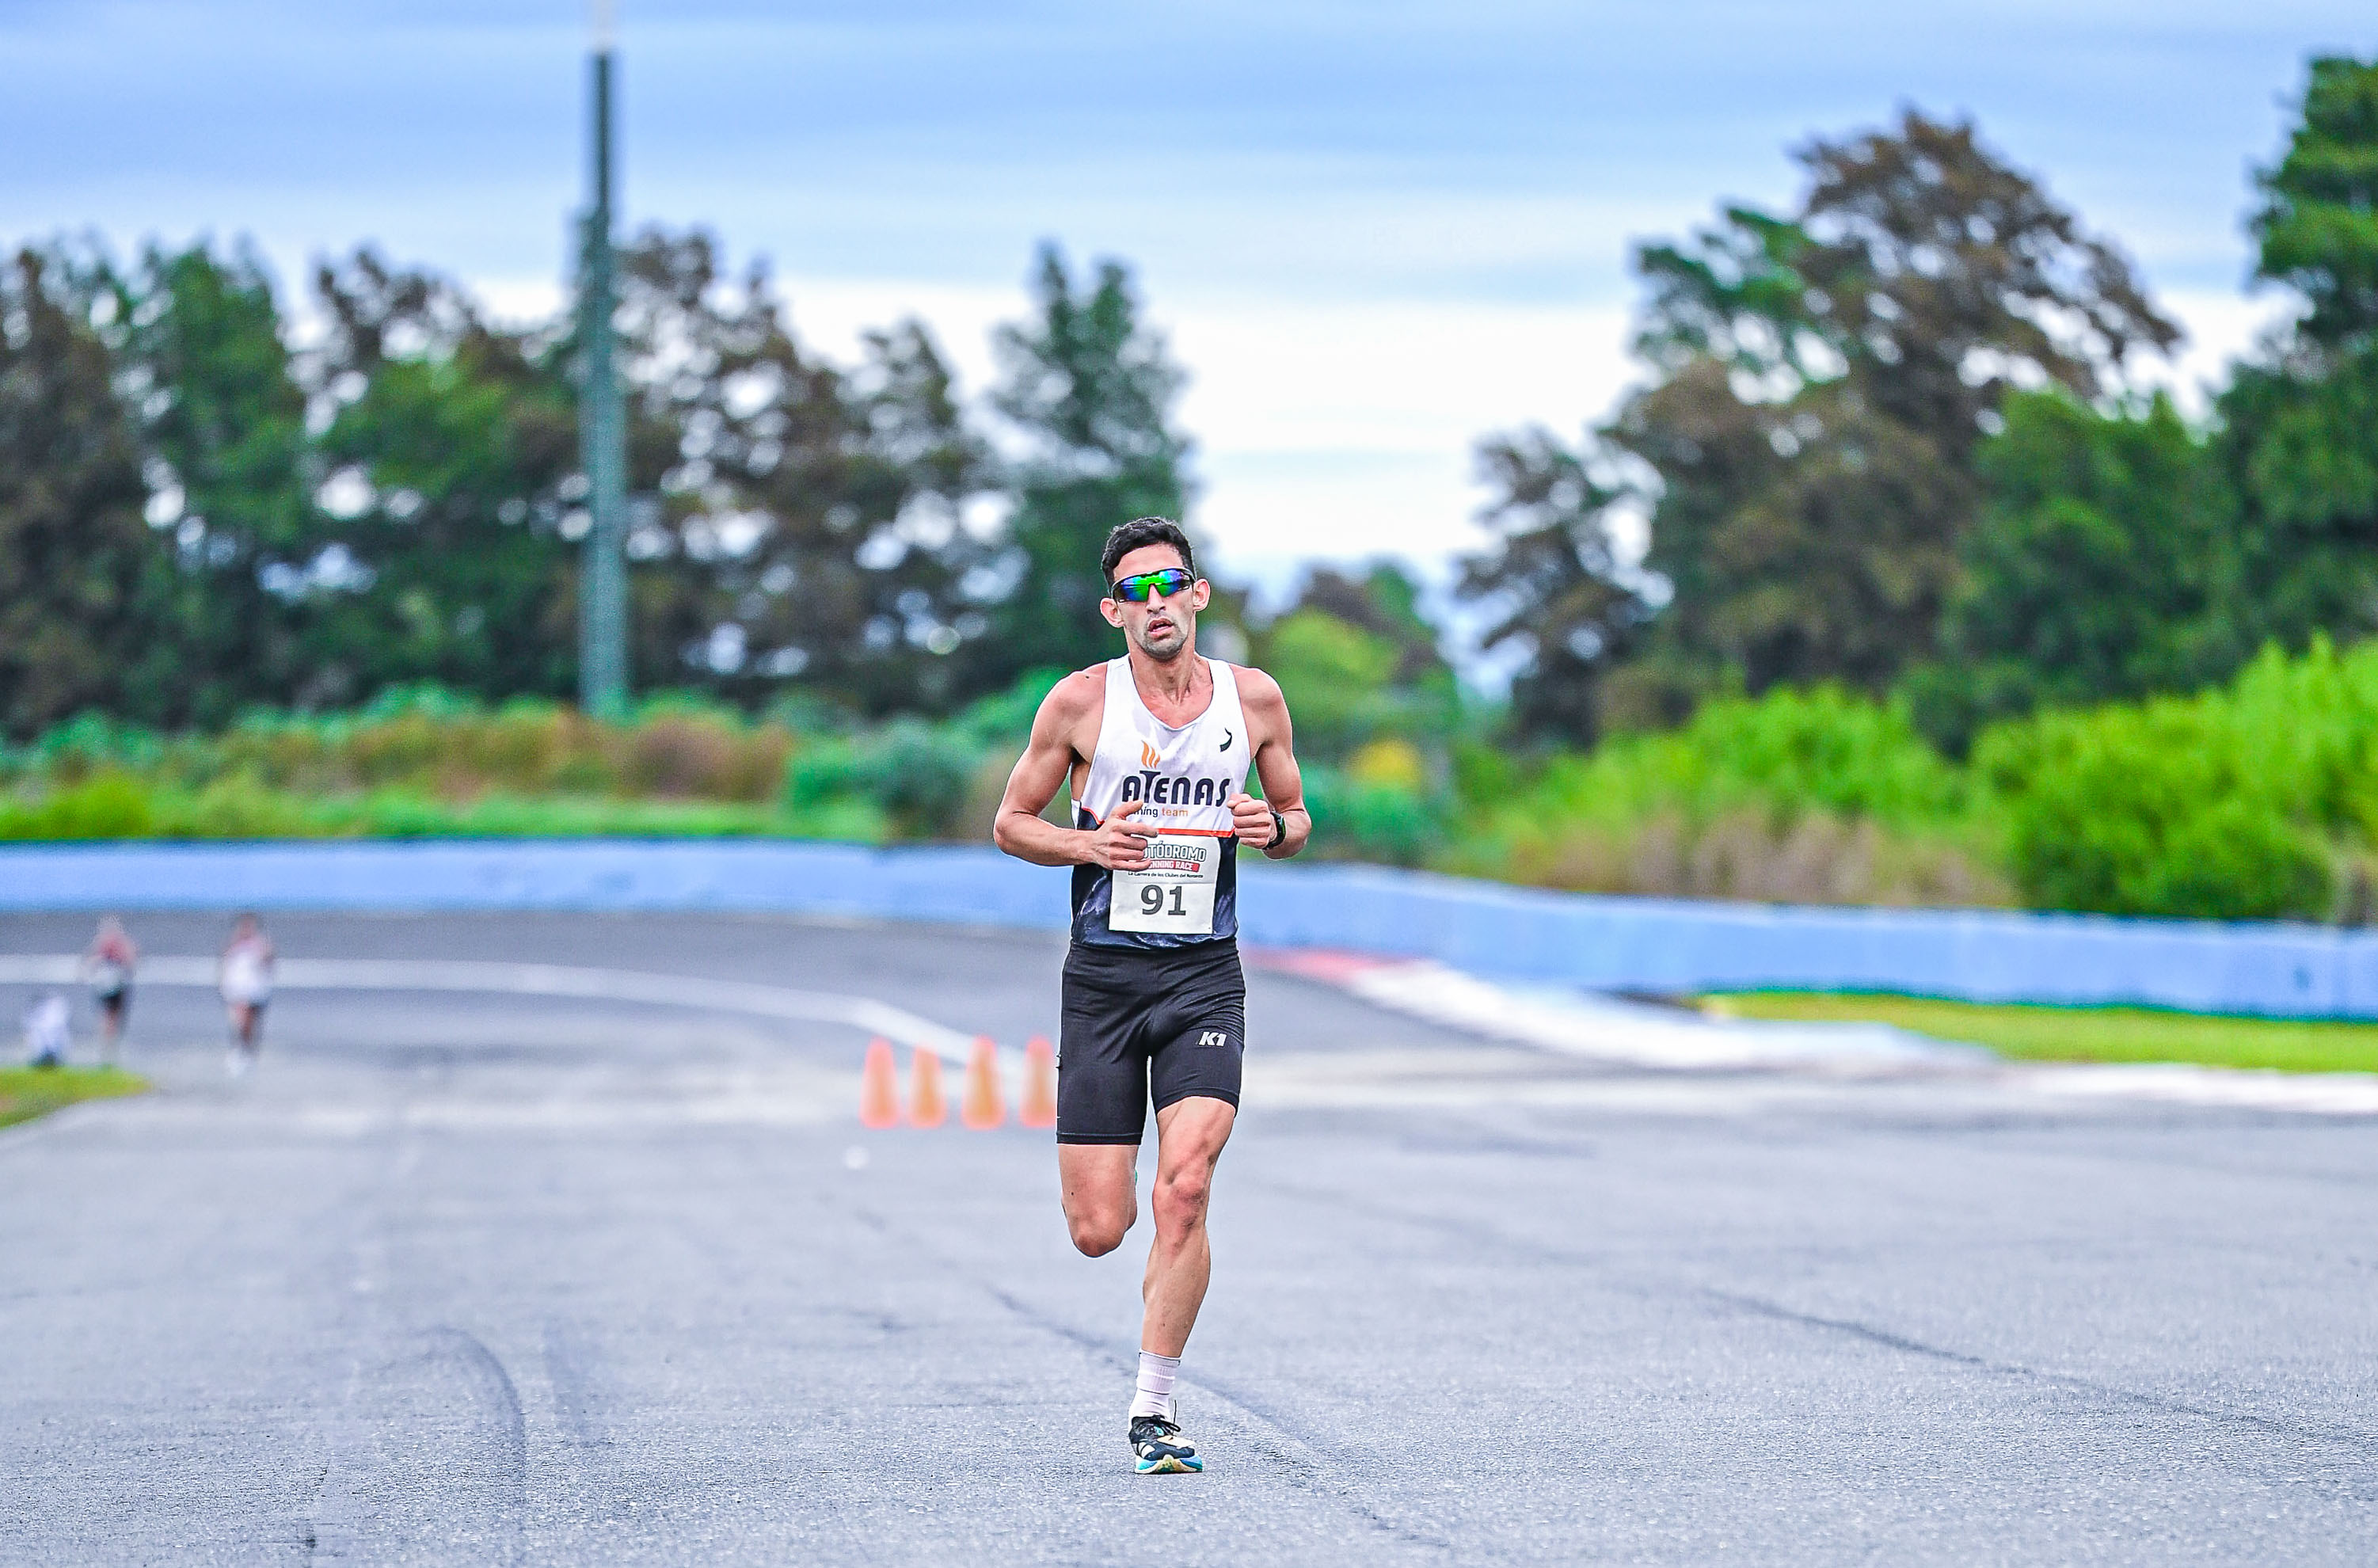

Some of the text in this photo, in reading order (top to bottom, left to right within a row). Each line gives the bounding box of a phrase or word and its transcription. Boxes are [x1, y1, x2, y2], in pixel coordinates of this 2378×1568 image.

[1122, 771, 1231, 807] ATENAS
[1162, 807, 1188, 816] team
[1175, 861, 1193, 871] RACE
[1141, 885, 1186, 915] 91
[1198, 1031, 1227, 1047] K1
